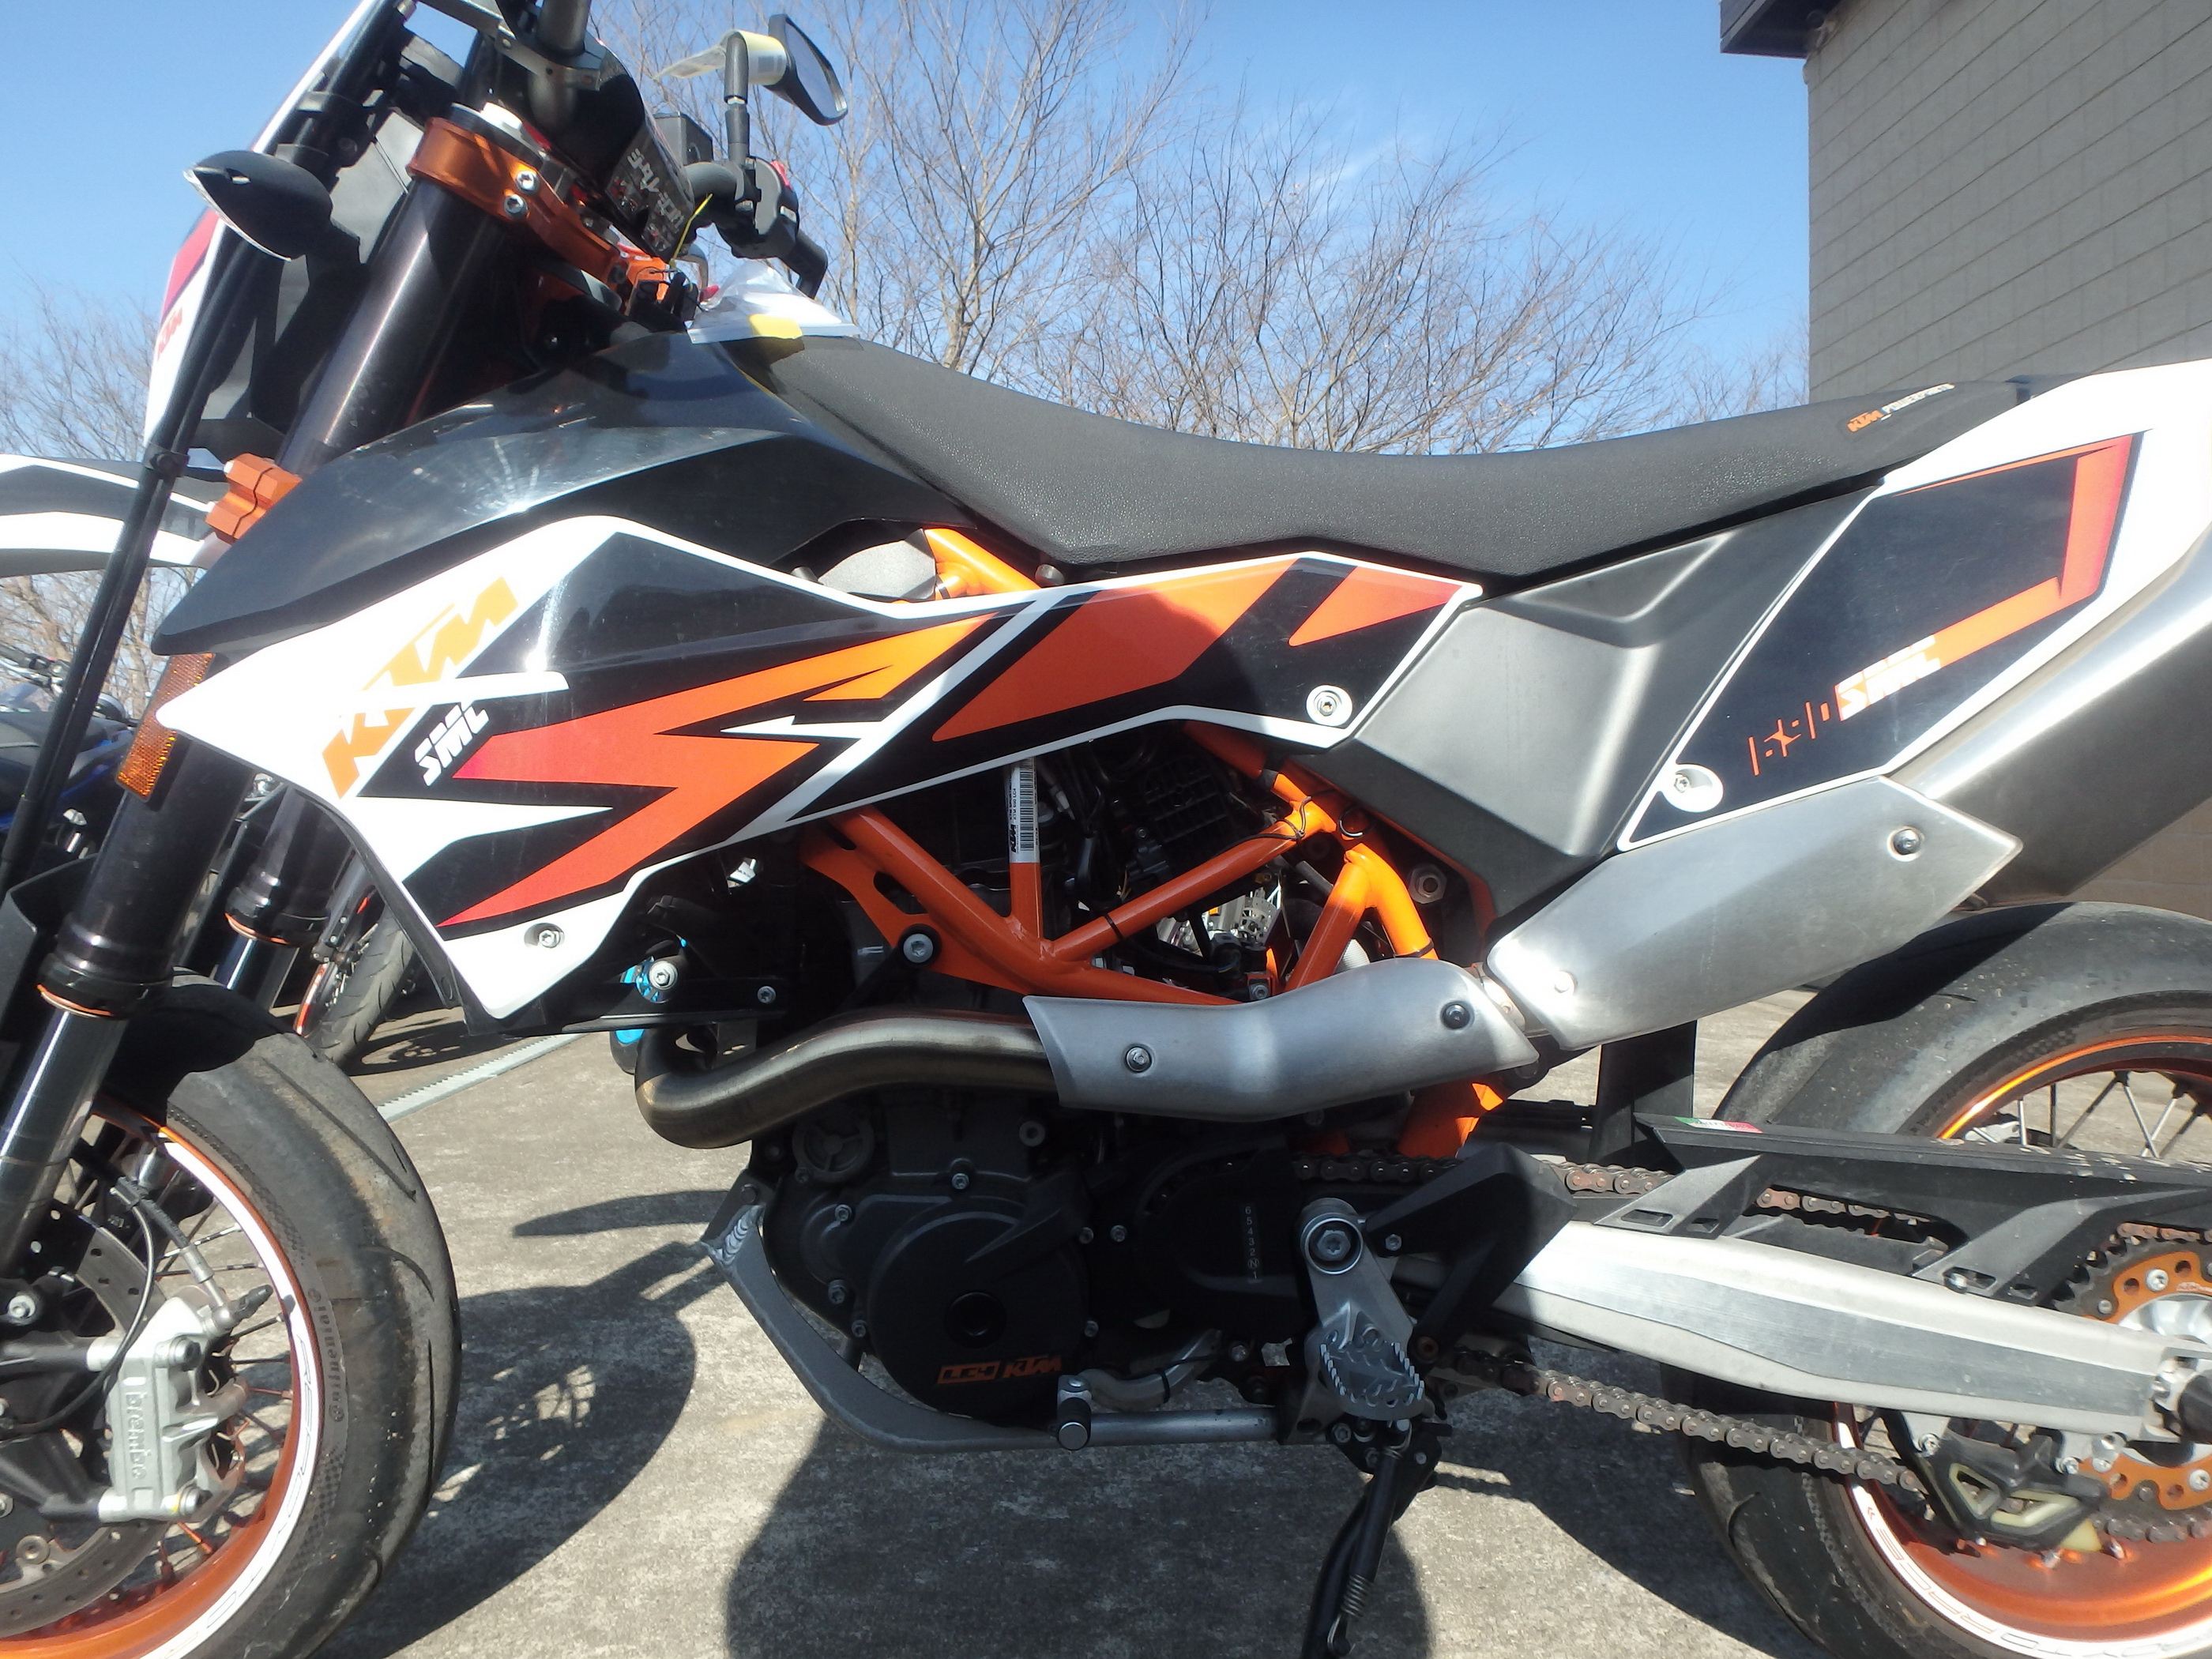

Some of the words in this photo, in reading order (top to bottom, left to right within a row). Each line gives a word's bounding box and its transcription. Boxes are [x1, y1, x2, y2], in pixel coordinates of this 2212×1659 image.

[1847, 409, 1884, 432] KTM
[322, 576, 518, 799] KTM
[415, 702, 490, 786] SMC
[1245, 1206, 1251, 1215] 6
[1247, 1227, 1254, 1236] 4
[1248, 1237, 1255, 1246] 3
[938, 1362, 1000, 1382] LC4
[1003, 1354, 1062, 1379] KTM
[126, 1390, 152, 1480] brembo
[1874, 1527, 1999, 1635] RACE
